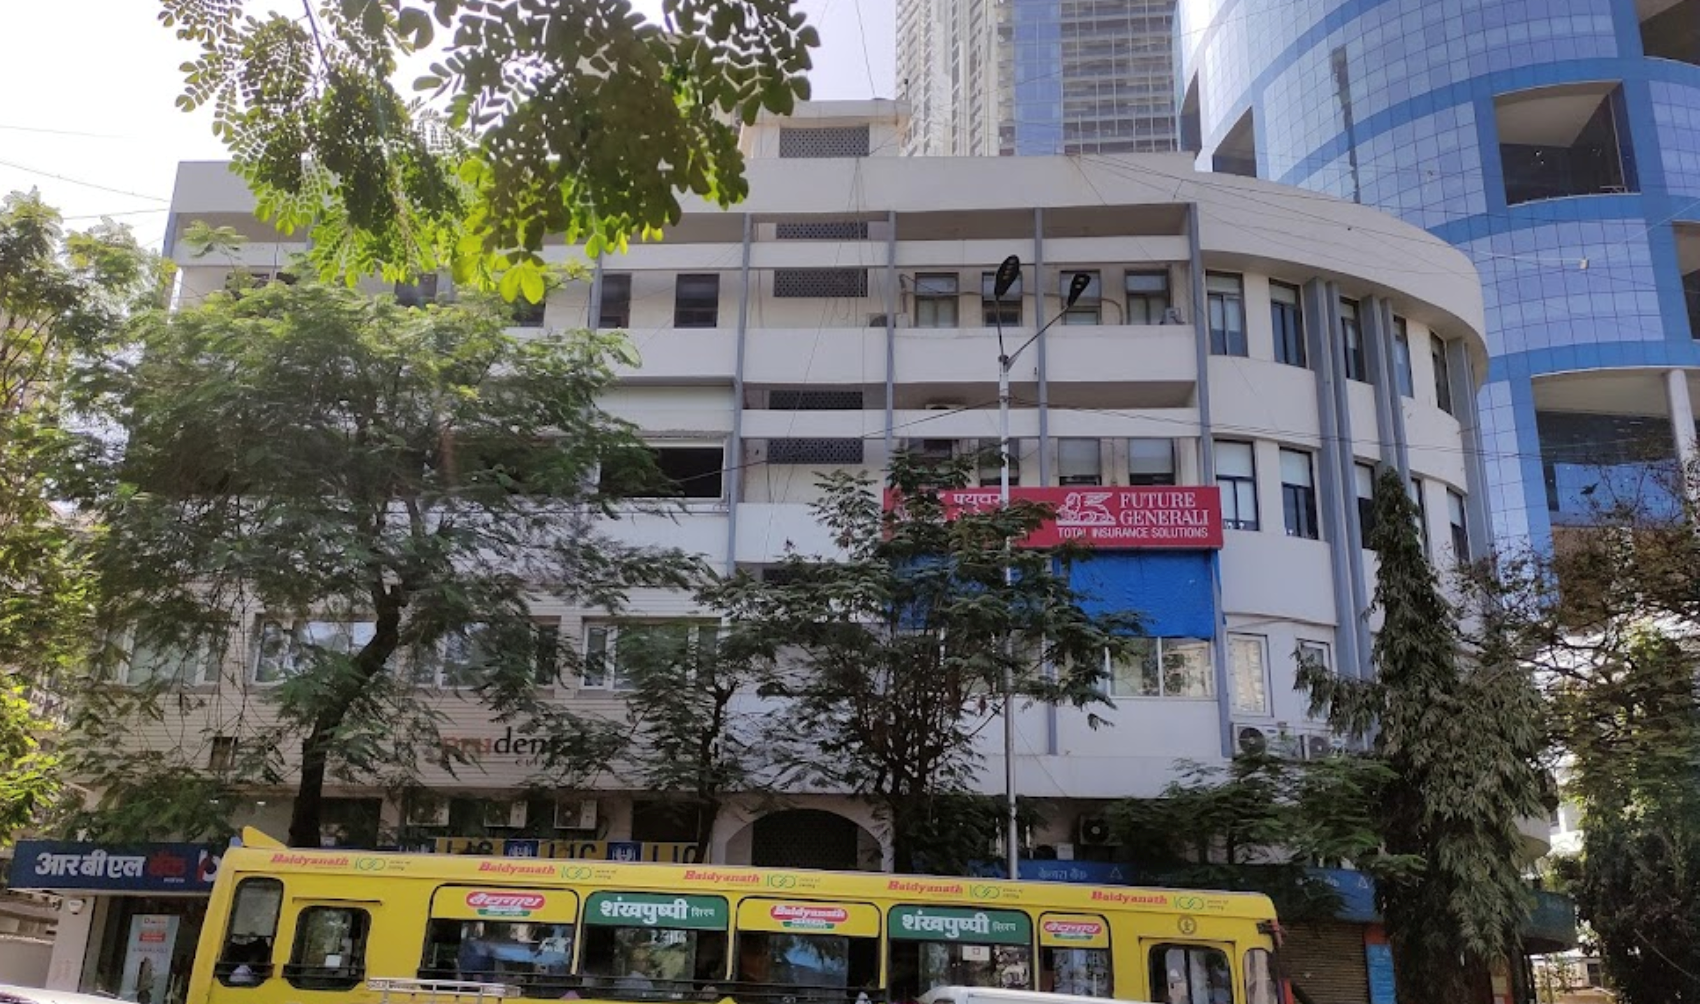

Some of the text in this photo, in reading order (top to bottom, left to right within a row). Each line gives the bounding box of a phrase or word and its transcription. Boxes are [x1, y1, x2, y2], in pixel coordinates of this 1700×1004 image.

[1119, 491, 1196, 508] FUTURE
[1119, 509, 1209, 526] GENERALI
[1151, 527, 1209, 539] SOLUTIONS
[35, 849, 146, 879] आरबीएल
[271, 853, 349, 867] Baidyanath
[478, 861, 555, 875] Baidyanath
[684, 869, 760, 884] Baidyanath
[887, 880, 964, 895] Baidyanath
[1090, 890, 1168, 905] Baidyanath
[600, 896, 688, 924] शंखपुष्पी
[902, 909, 989, 938] शंखपुष्पी
